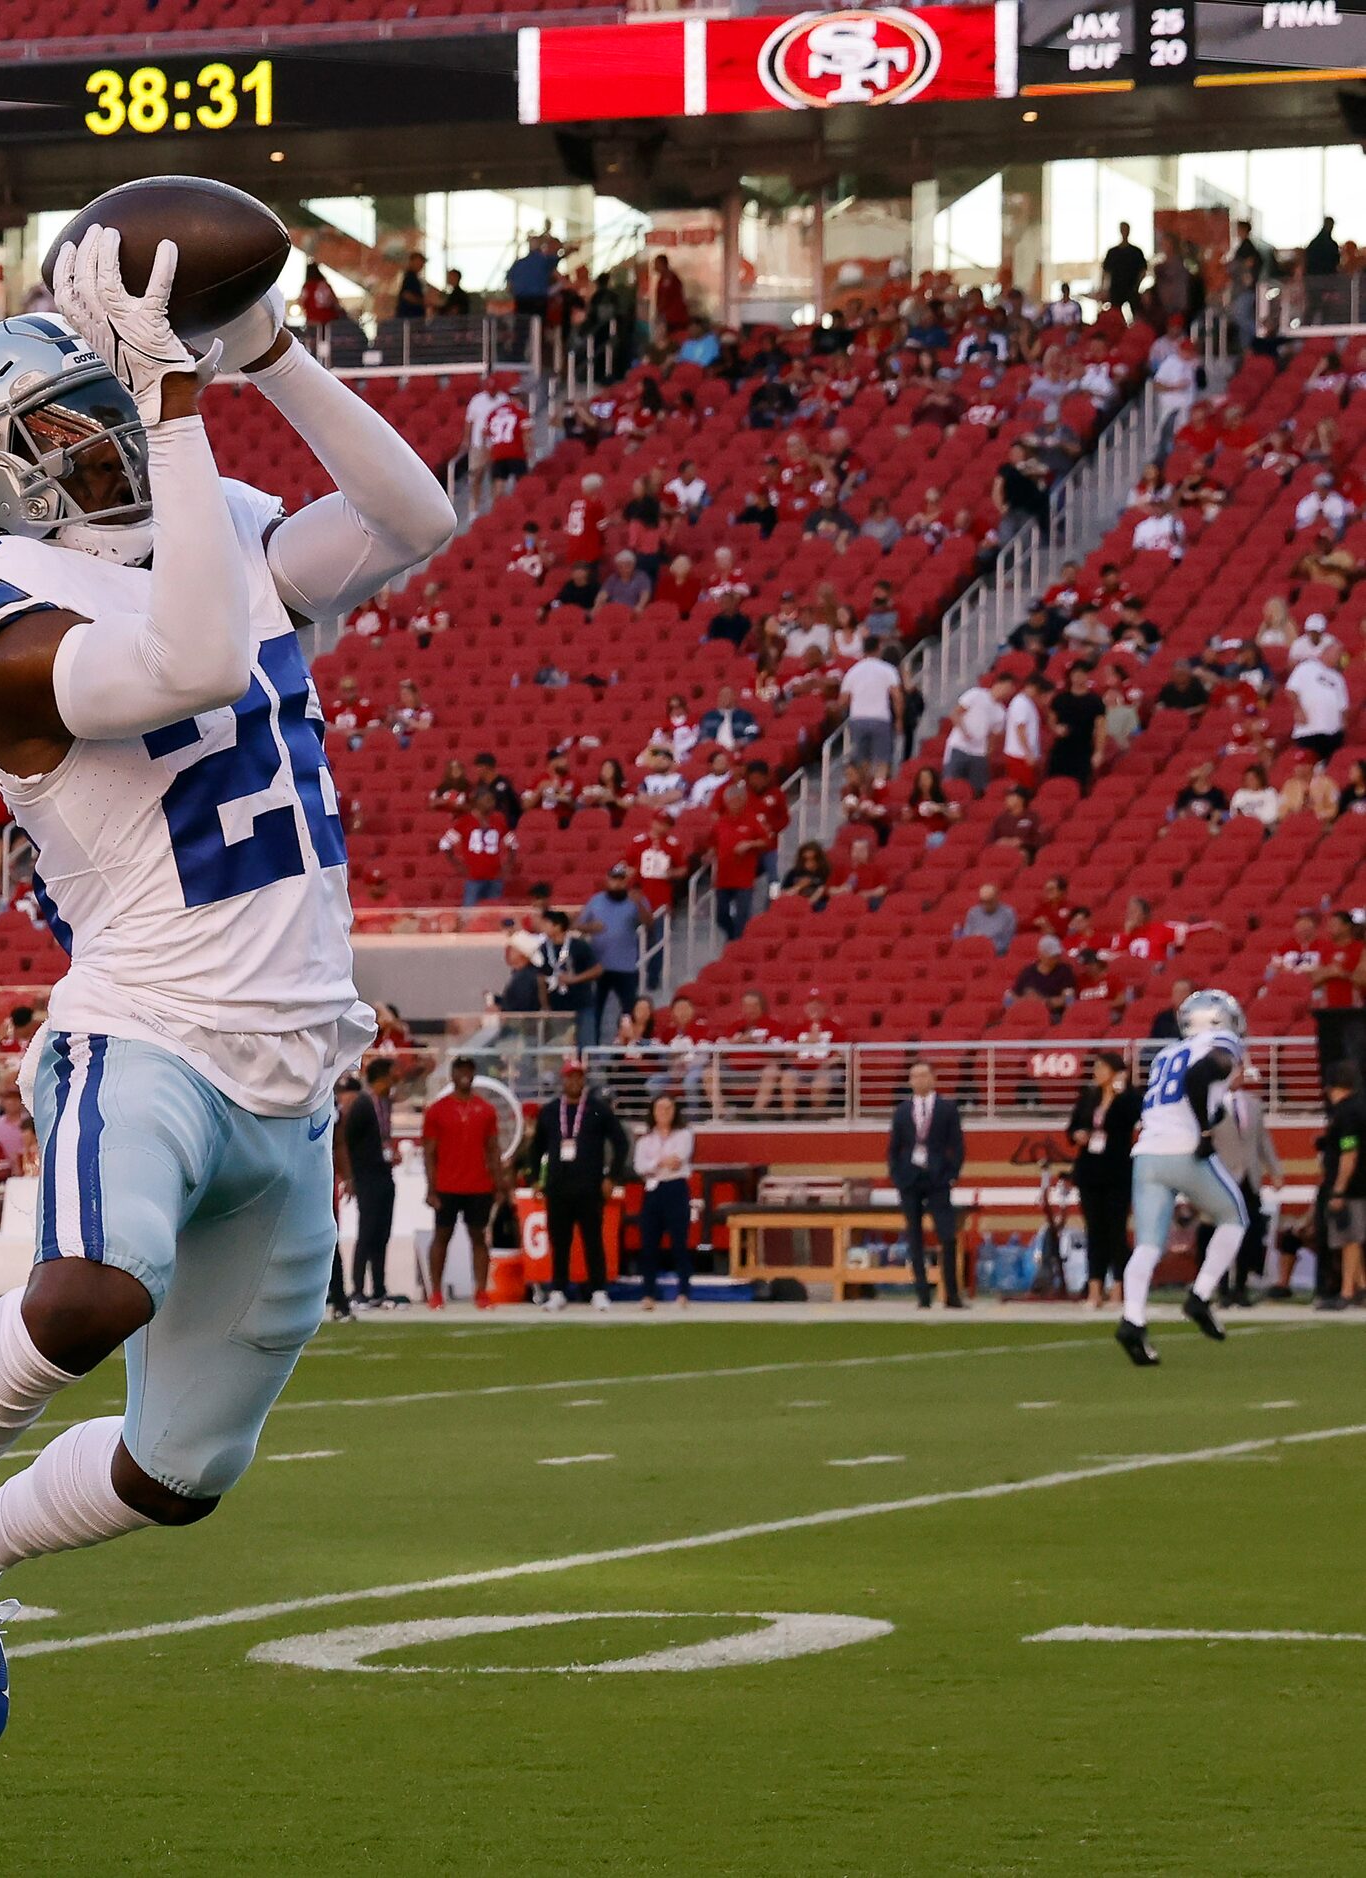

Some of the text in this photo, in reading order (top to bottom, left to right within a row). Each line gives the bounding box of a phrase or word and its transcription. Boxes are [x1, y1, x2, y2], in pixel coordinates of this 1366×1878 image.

[1067, 11, 1121, 40] JAX
[1262, 0, 1343, 29] FINAL
[1068, 39, 1187, 71] BUF 20
[84, 60, 273, 135] 38:31
[73, 351, 100, 364] COW
[1030, 1052, 1078, 1077] 140
[1141, 1049, 1191, 1110] 28
